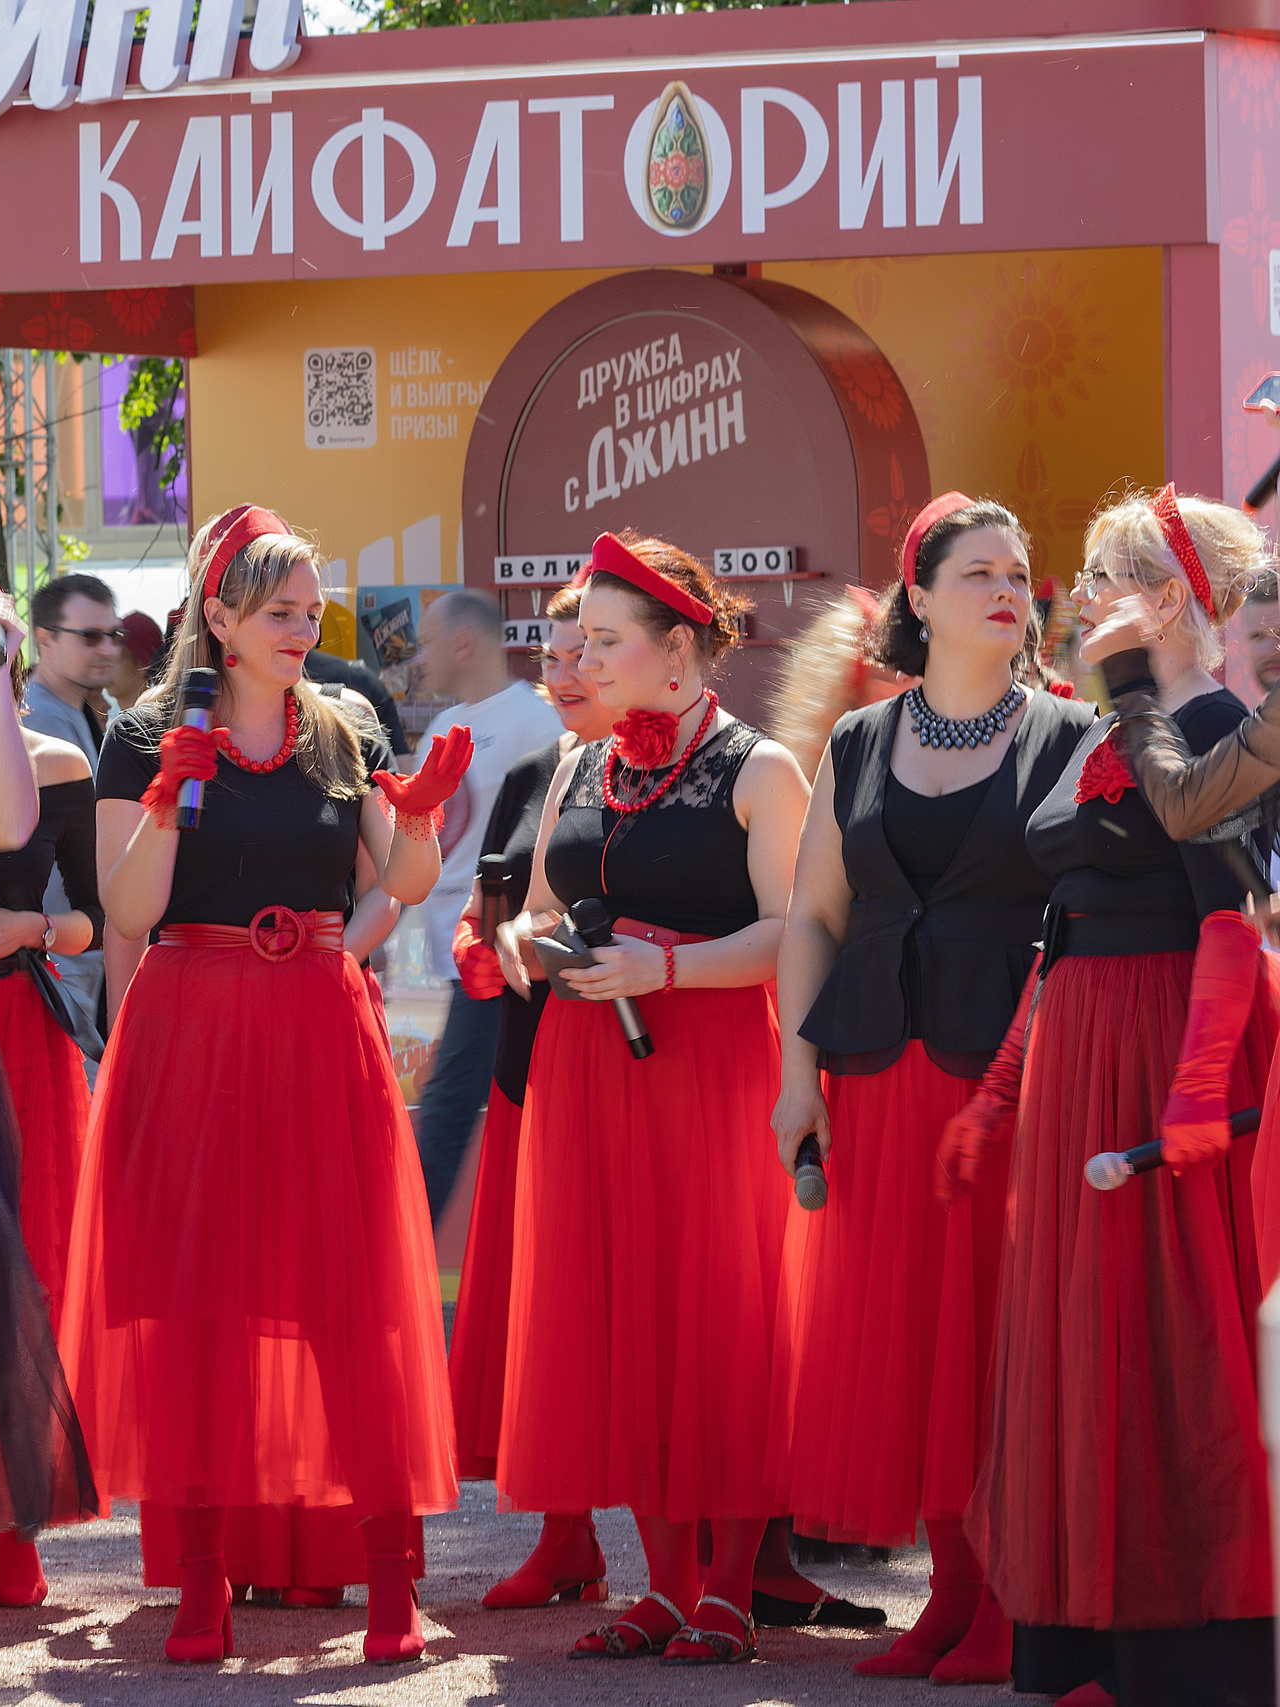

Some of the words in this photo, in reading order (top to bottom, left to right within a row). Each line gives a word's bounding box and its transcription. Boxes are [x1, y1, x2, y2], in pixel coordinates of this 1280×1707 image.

[79, 53, 984, 263] КАЙФАТОРИЙ
[389, 347, 442, 378] ЩЁЛК
[577, 332, 683, 410] ДРУЖБА
[390, 383, 402, 408] И
[407, 380, 491, 408] ВЫИГРЫ
[615, 393, 631, 430] В
[637, 347, 742, 421] ЦИФРАХ
[390, 414, 458, 440] ПРИЗЫ!
[500, 560, 580, 578] вели
